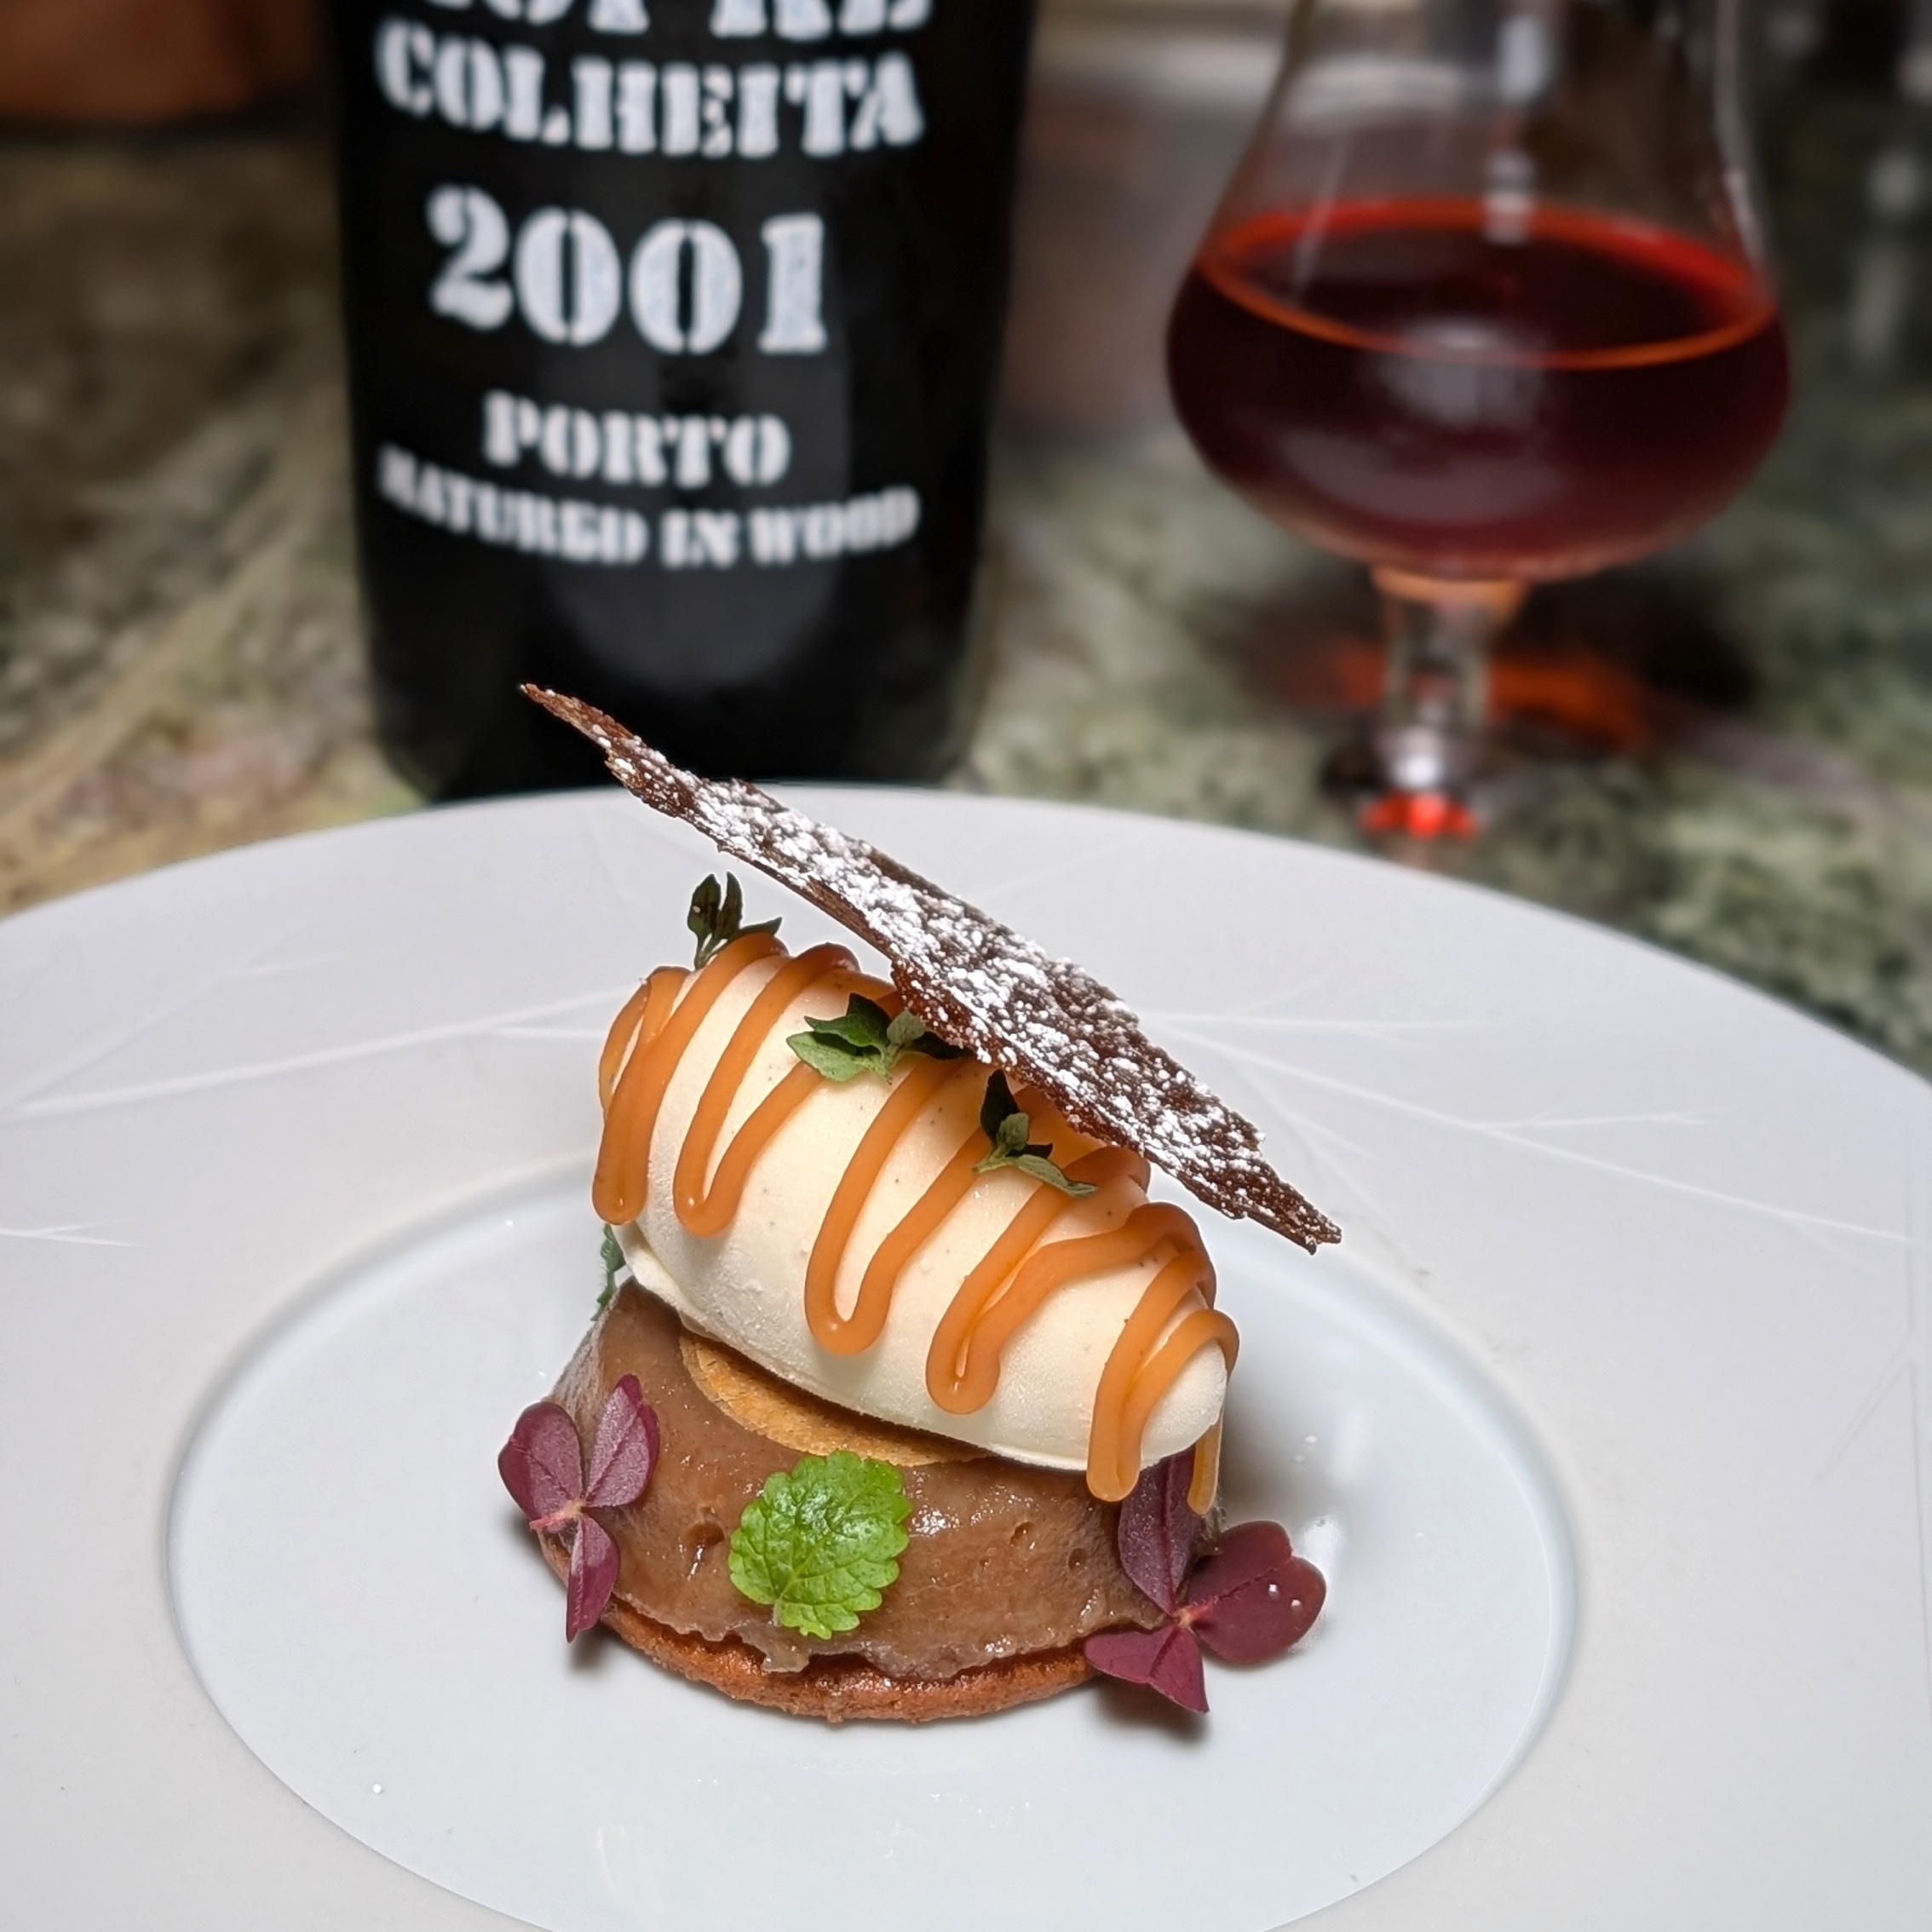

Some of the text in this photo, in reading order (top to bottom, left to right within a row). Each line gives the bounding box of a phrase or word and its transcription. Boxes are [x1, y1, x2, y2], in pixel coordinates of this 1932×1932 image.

[377, 20, 923, 158] COLHEITA
[428, 187, 828, 354] 2001
[484, 391, 791, 488] PORTO
[380, 446, 919, 569] MATURED IN WOOD
